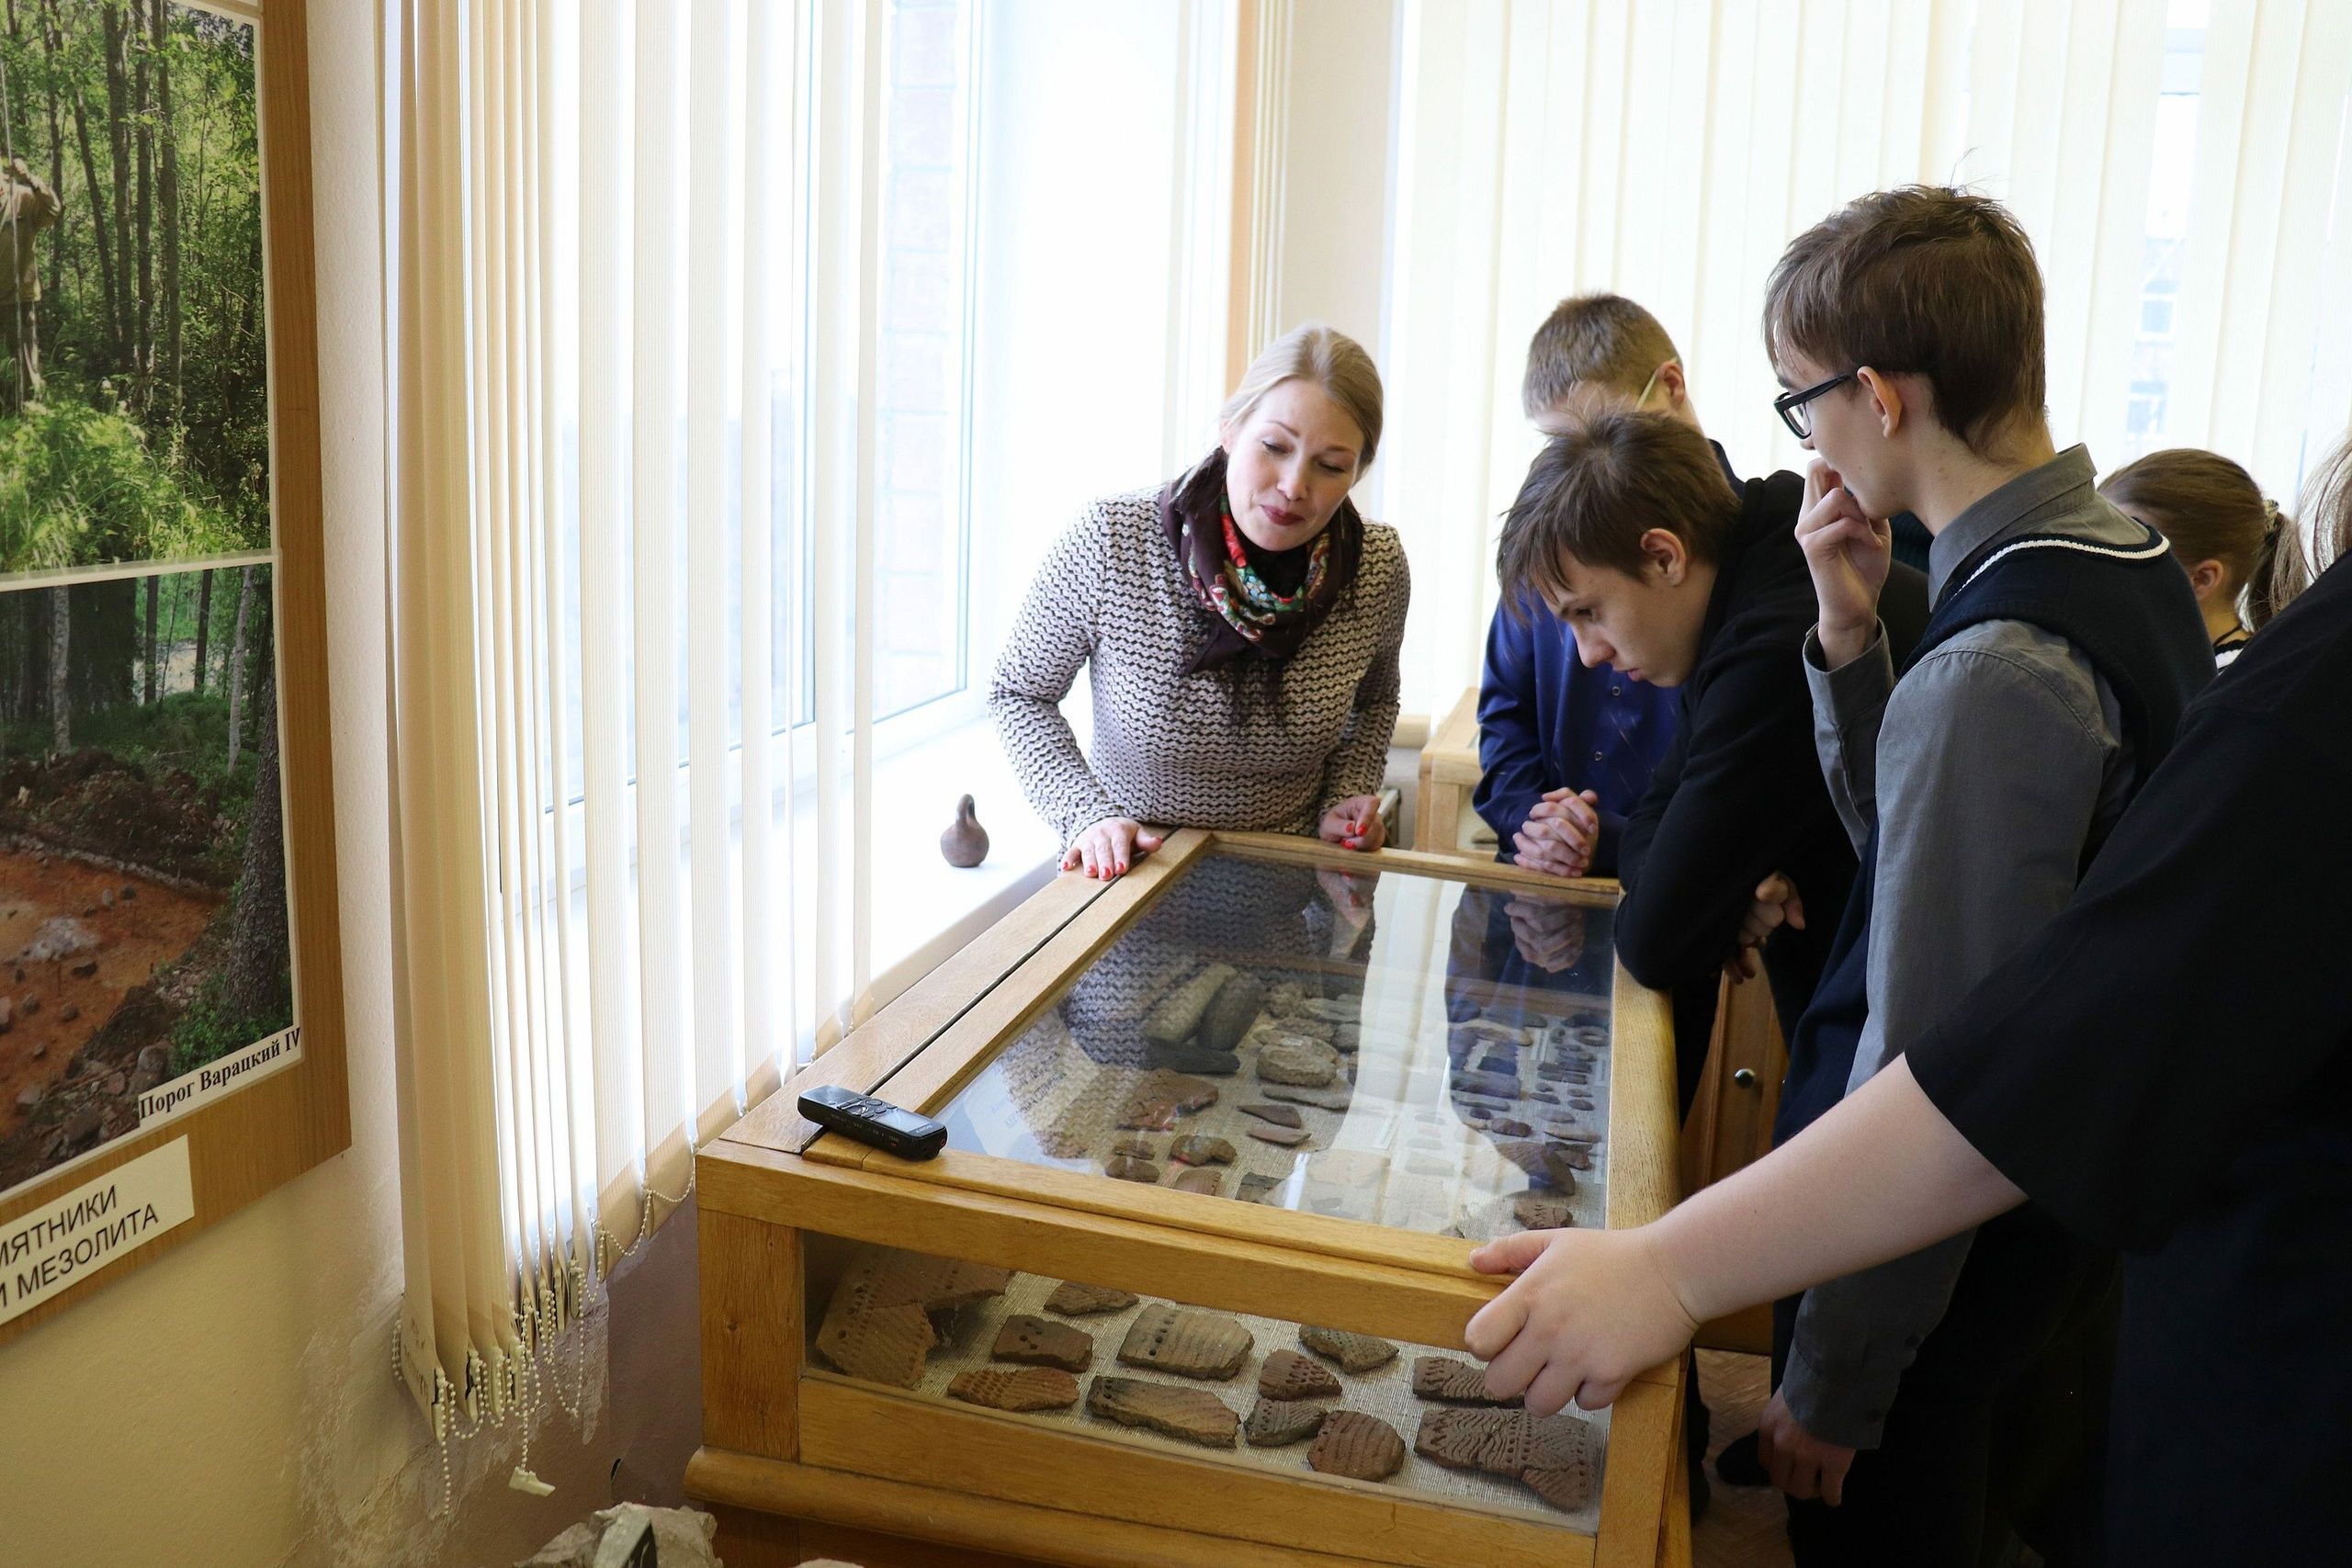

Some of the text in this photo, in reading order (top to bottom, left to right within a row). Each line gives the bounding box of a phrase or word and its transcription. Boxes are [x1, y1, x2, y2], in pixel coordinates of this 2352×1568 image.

[140, 1027, 301, 1120] Порог Варацкий IV
[17, 1203, 159, 1300] МЕЗОЛИТА
